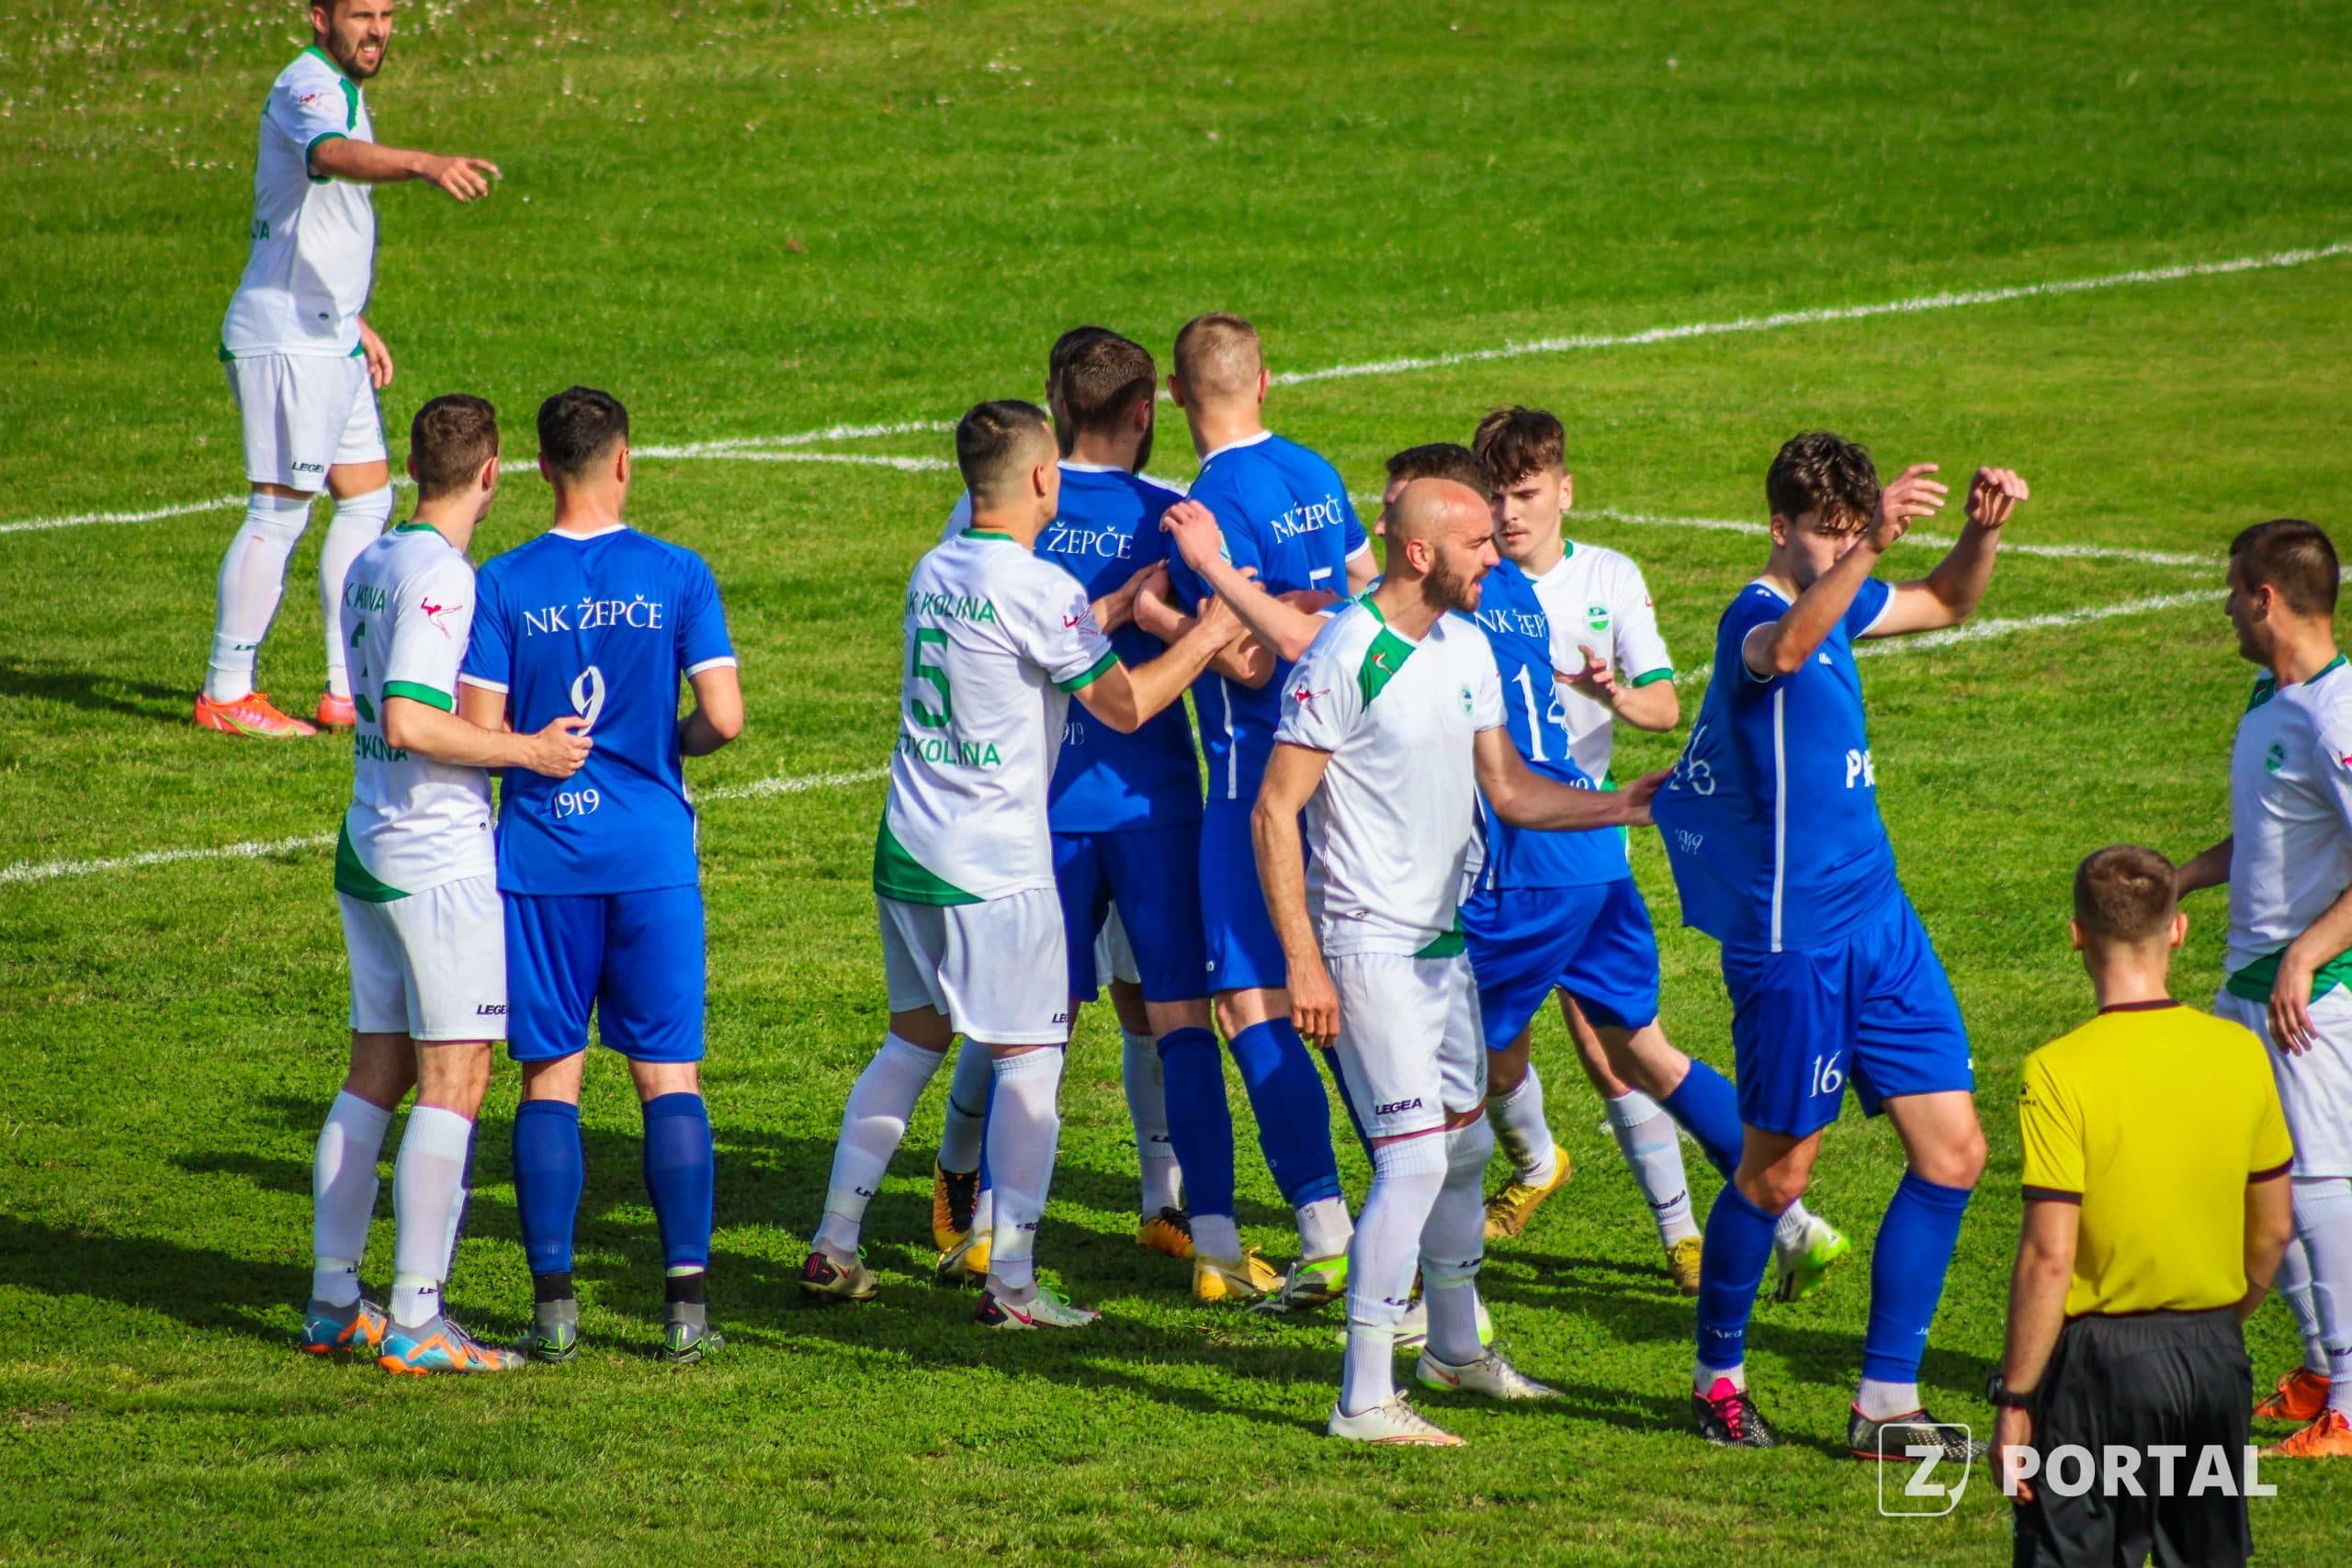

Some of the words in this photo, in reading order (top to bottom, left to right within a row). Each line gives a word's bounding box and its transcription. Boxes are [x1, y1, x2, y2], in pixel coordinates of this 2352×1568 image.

[1046, 521, 1134, 559] ŽEPČE
[523, 604, 571, 637] NK
[576, 593, 663, 630] ŽEPČE
[920, 592, 996, 625] KOLINA
[1473, 608, 1514, 634] NK
[910, 626, 953, 729] 5
[571, 665, 606, 737] 9
[553, 788, 601, 819] 1919
[476, 1003, 507, 1016] LEGE
[1809, 1050, 1844, 1099] 16
[1374, 1097, 1423, 1116] LEGEA
